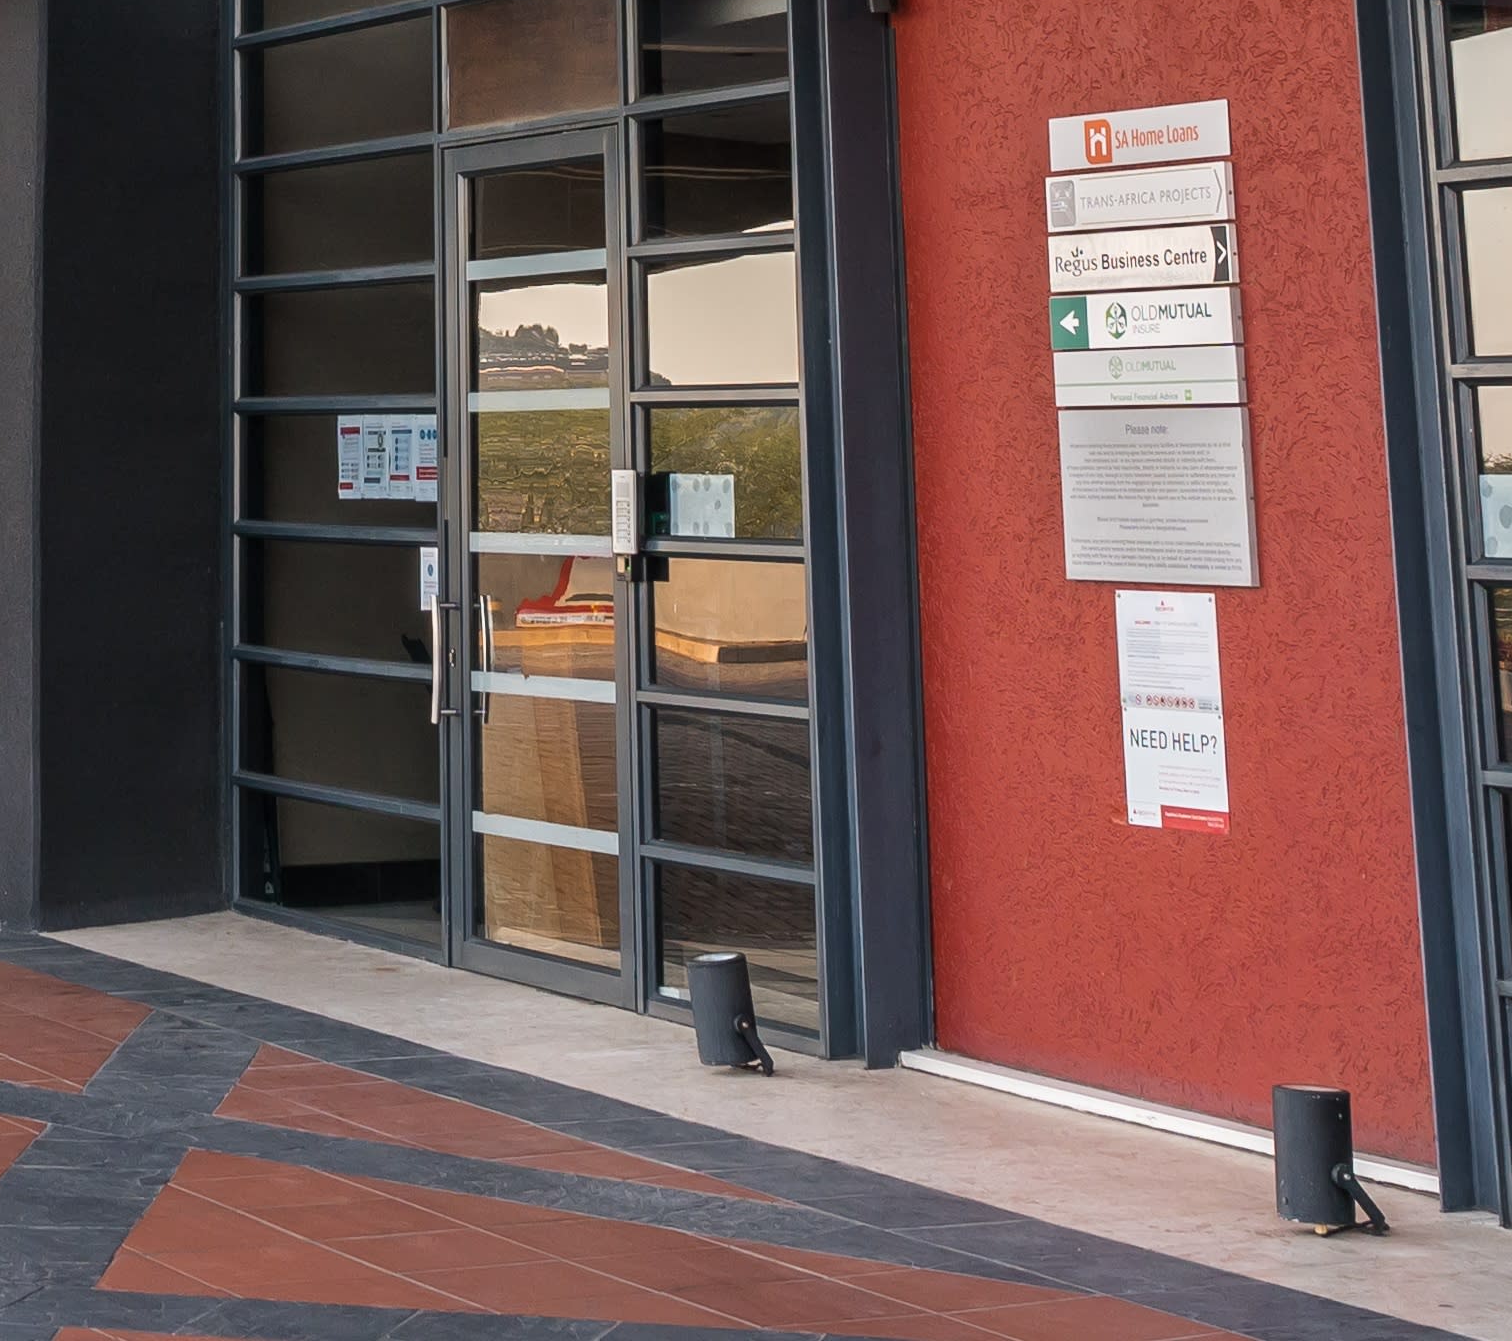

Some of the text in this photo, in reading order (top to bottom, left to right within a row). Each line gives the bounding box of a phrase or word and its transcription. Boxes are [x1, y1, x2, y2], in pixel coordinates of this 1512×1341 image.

[1115, 125, 1199, 149] SA Home Loans
[1080, 191, 1156, 209] TRANS-AFRICA
[1160, 187, 1211, 204] PROJECTS
[1055, 249, 1207, 276] Regus Business Centre
[1133, 324, 1160, 334] INSURE
[1125, 424, 1149, 435] Please
[1130, 728, 1218, 755] NEED HELP?
